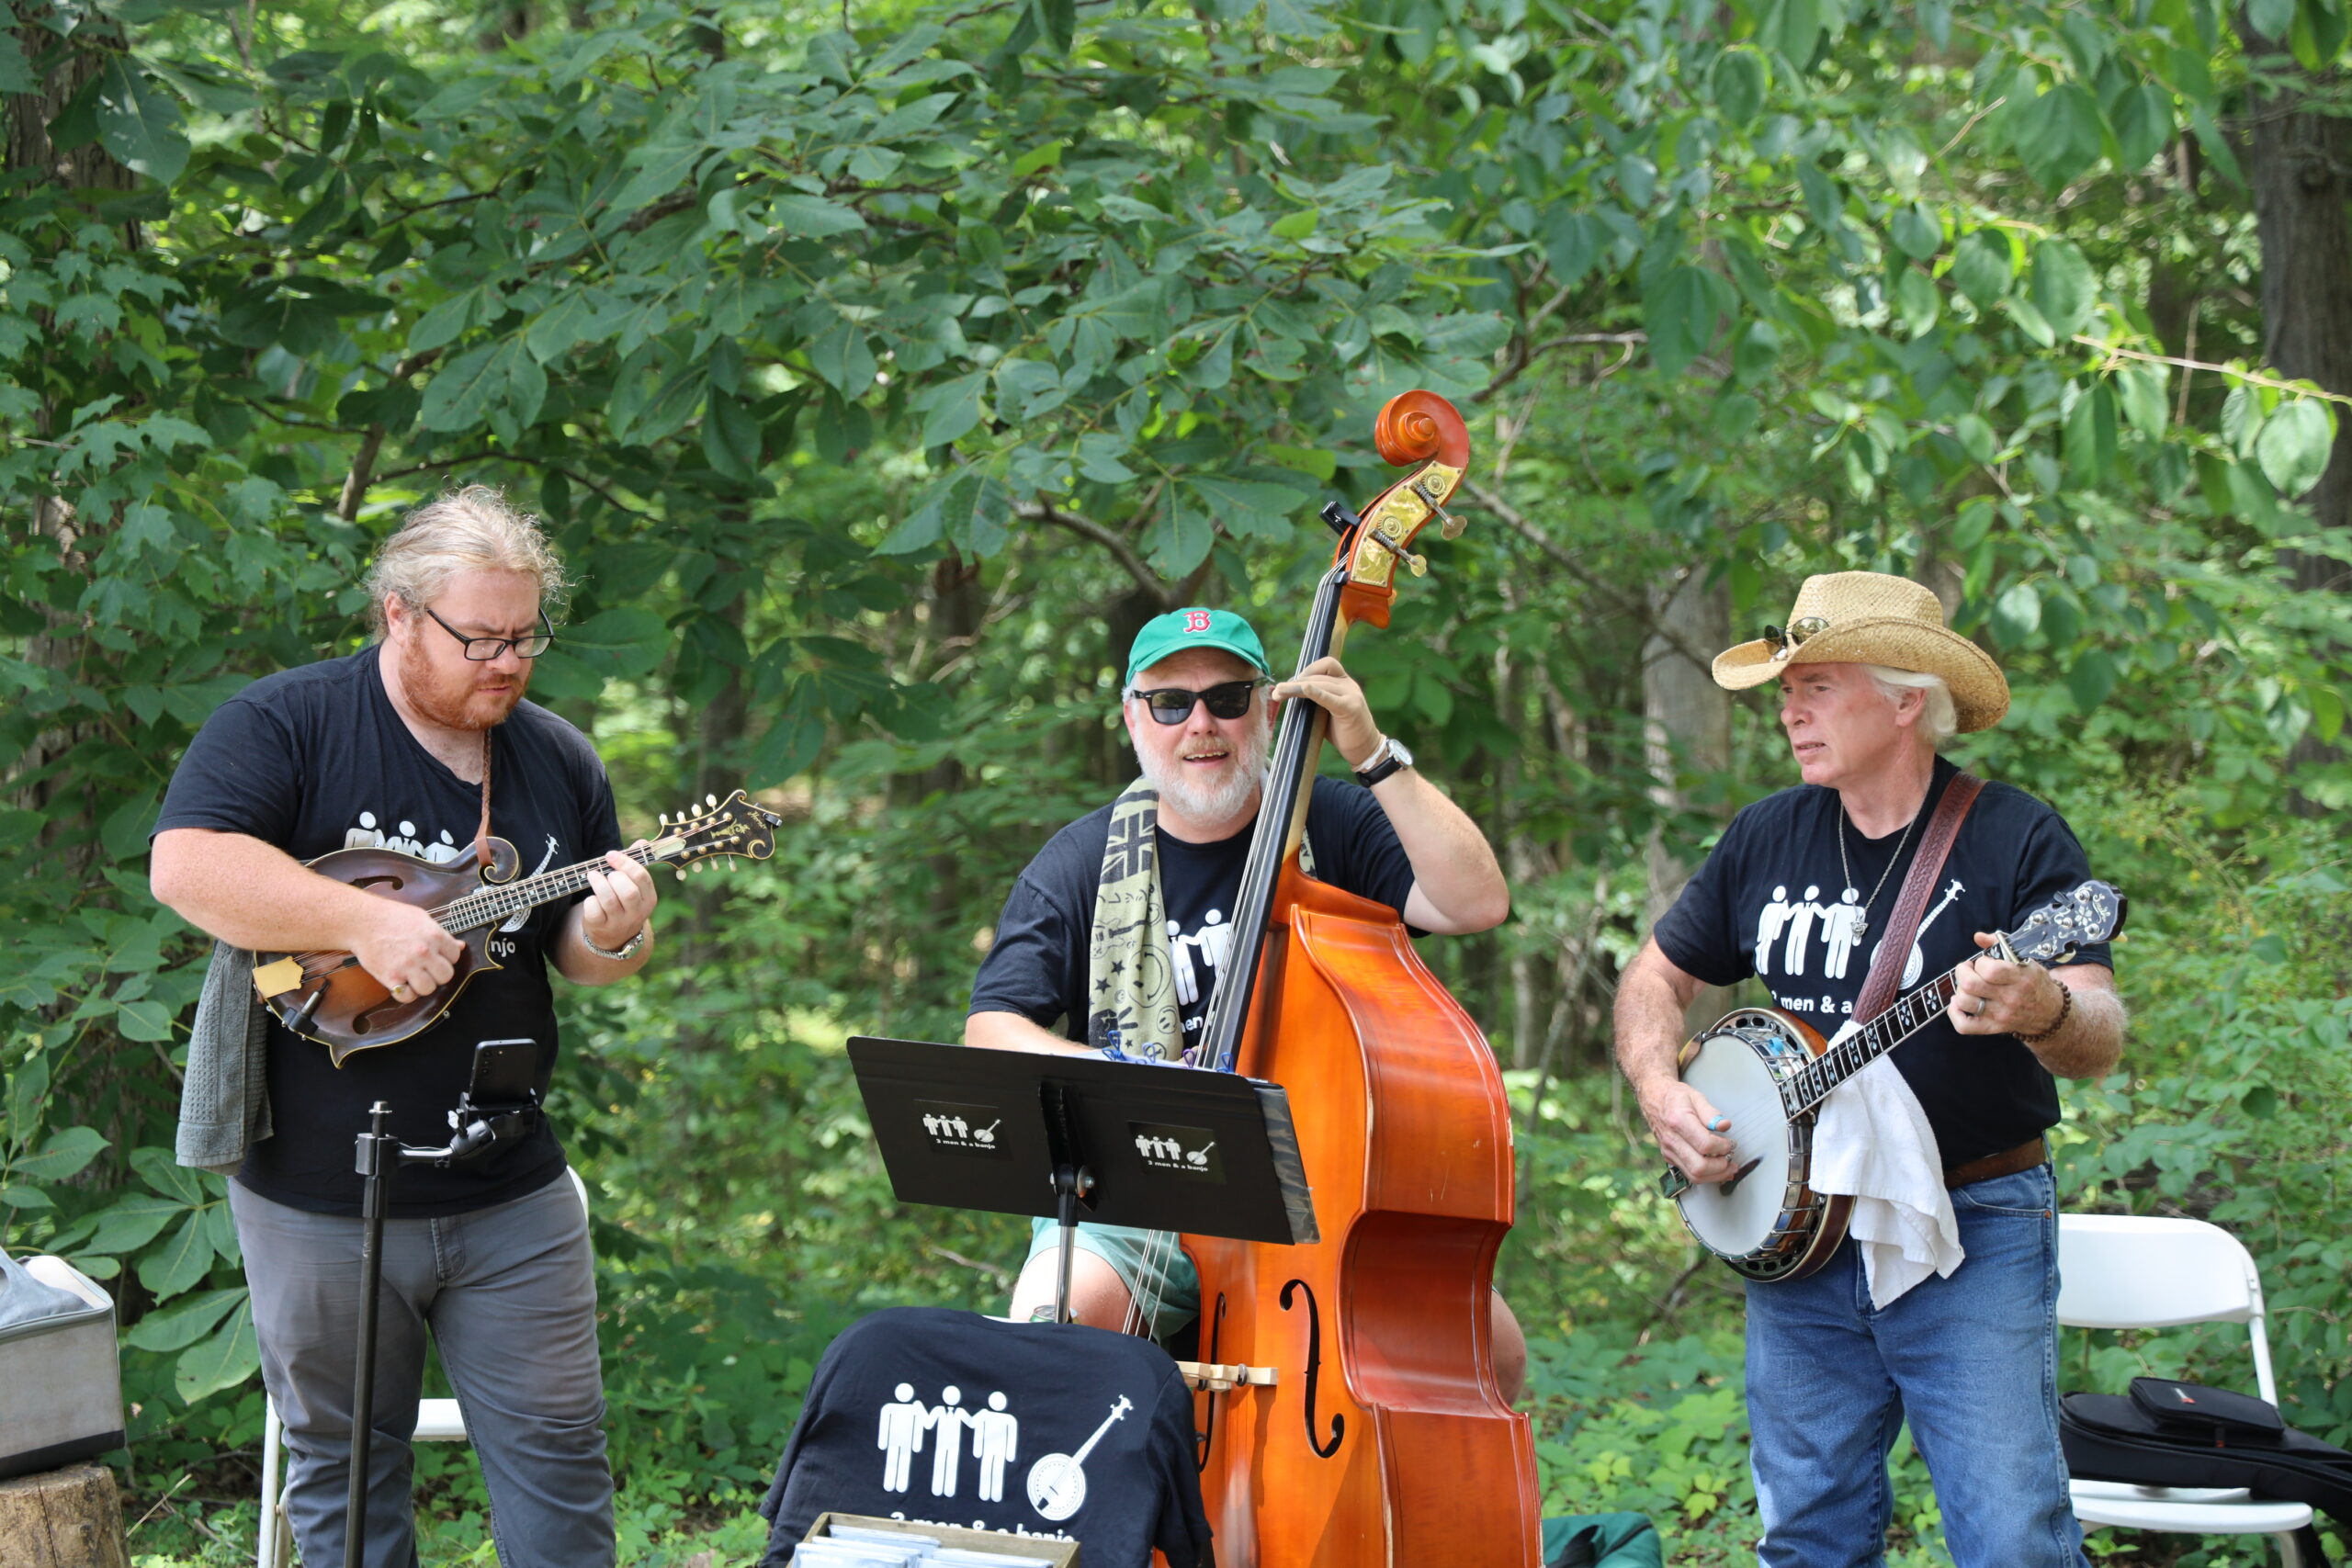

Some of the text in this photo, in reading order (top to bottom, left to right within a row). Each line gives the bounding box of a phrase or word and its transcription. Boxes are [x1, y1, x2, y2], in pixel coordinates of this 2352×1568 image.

[1182, 609, 1211, 633] B
[489, 937, 516, 958] njo
[1780, 995, 1853, 1014] men & a
[974, 1142, 996, 1150] banjo
[1186, 1164, 1209, 1172] banjo
